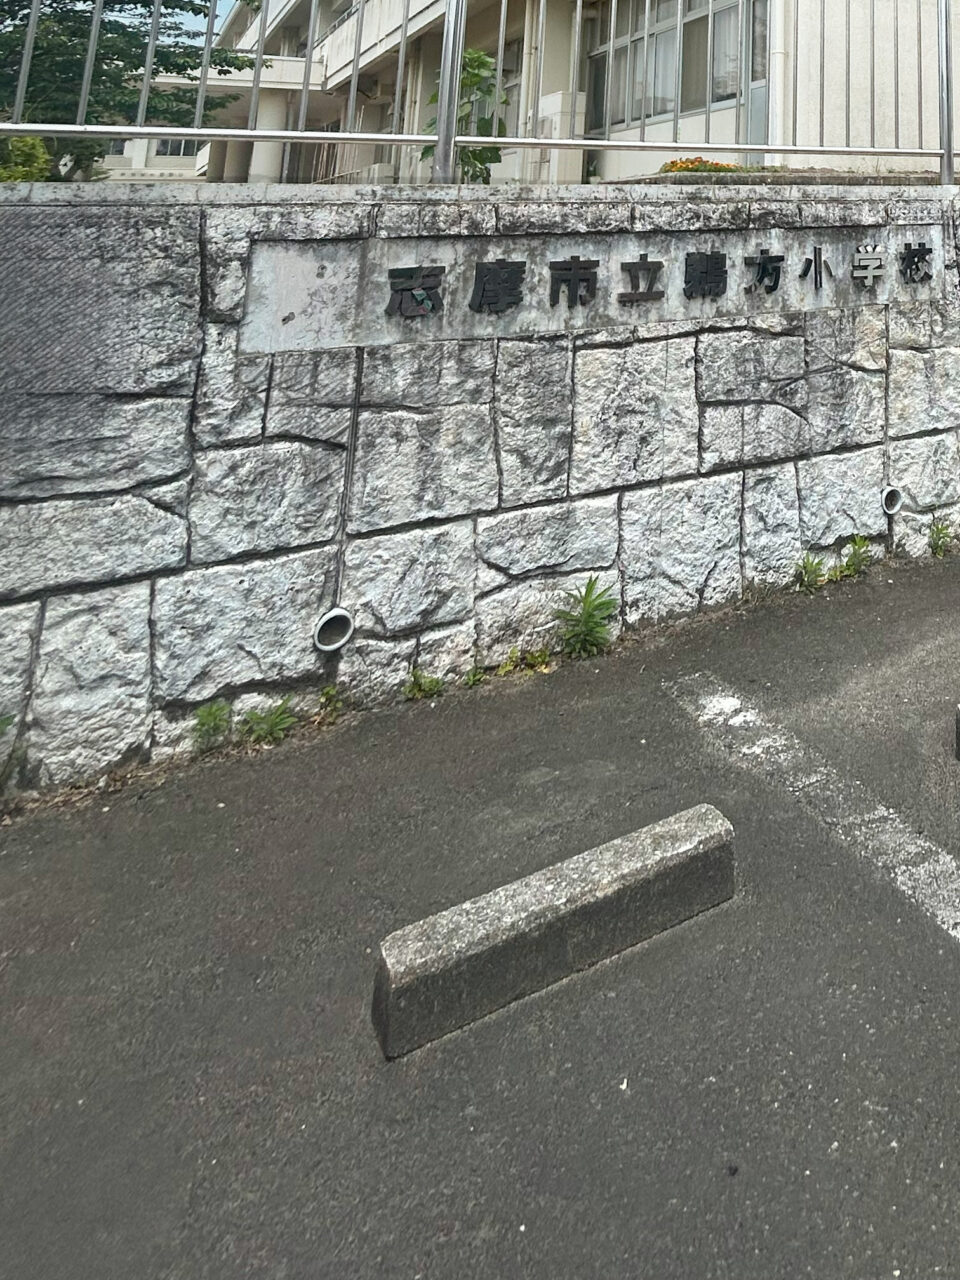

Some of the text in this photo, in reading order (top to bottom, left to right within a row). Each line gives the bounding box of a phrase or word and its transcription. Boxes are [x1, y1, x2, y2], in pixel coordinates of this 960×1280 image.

[384, 242, 934, 318] 志摩市立鵜方小学校
